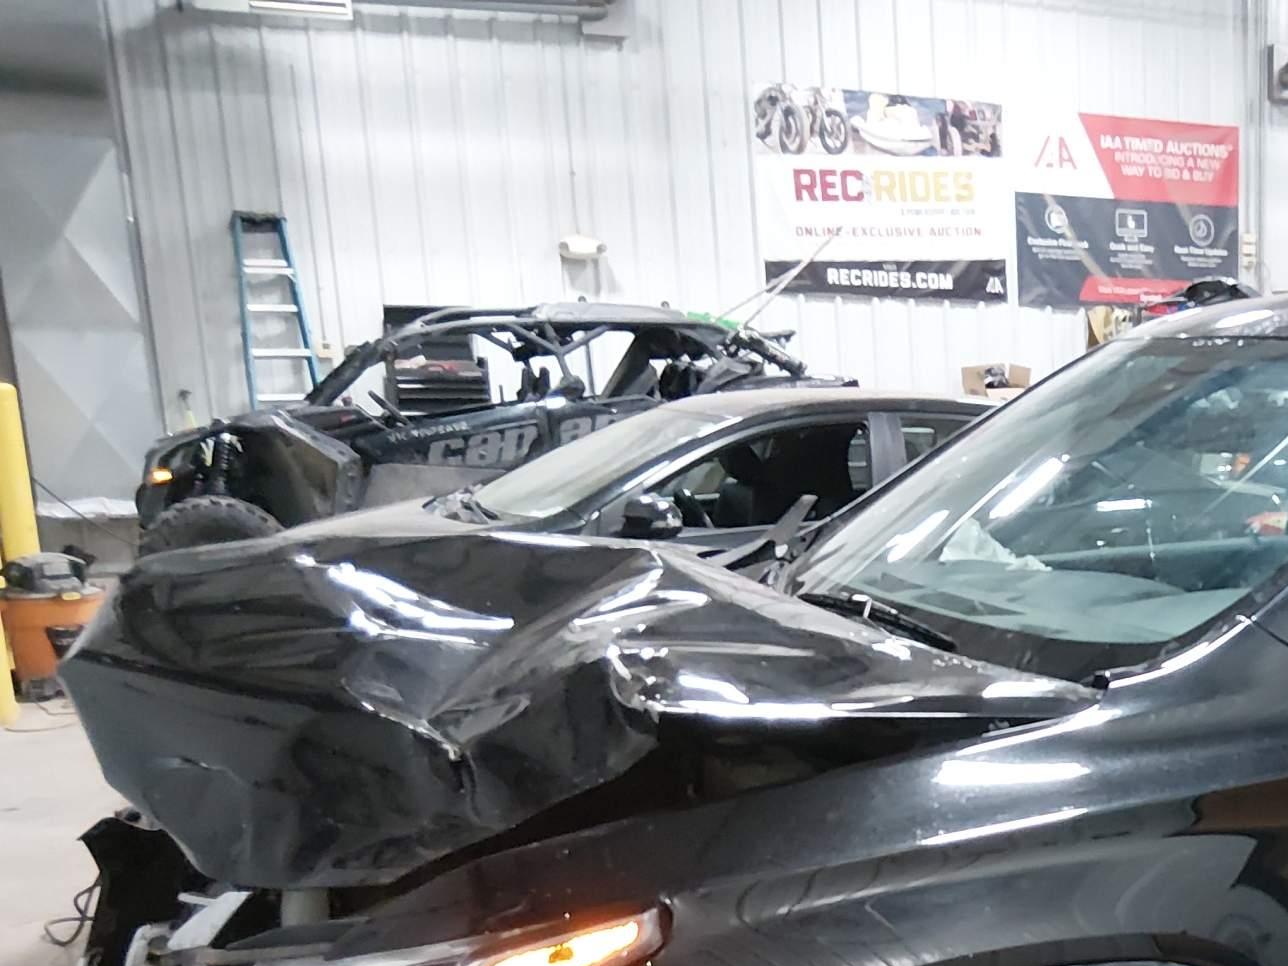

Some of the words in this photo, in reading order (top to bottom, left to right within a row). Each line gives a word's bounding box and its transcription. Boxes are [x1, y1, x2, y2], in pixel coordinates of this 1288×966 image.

[1147, 167, 1162, 178] TO
[873, 169, 975, 202] RIDES
[928, 227, 982, 237] AUCTION
[827, 268, 953, 291] RECRIDES.COM
